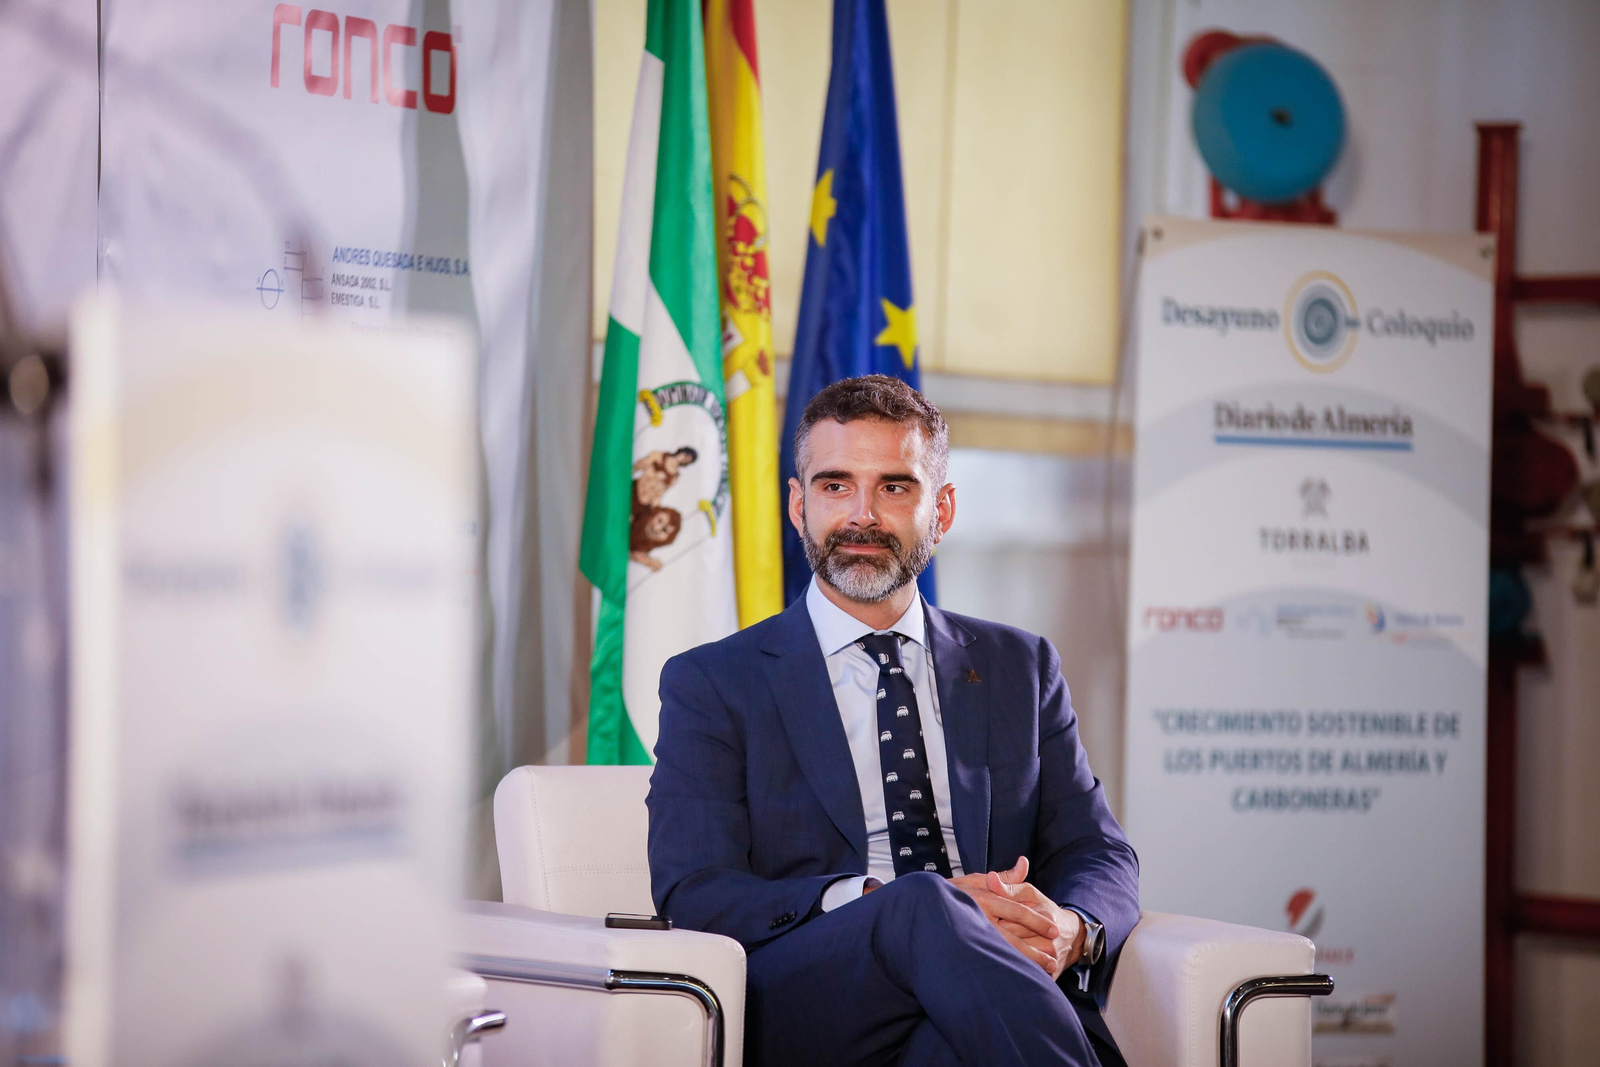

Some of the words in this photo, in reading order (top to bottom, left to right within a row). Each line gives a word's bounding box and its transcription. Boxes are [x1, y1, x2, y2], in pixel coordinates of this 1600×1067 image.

[270, 3, 458, 114] ronco
[1161, 296, 1280, 335] Desayuno
[1366, 308, 1475, 346] Coloquio
[1323, 404, 1414, 437] Almería
[1260, 527, 1371, 556] TORRALBA
[1144, 606, 1225, 633] ronco
[1307, 711, 1427, 737] SOSTENIBLE
[1432, 713, 1460, 738] DE
[1163, 749, 1202, 774] LOS
[1208, 749, 1301, 774] PUERTOS
[1307, 751, 1333, 774] DE
[1436, 751, 1448, 775] Y
